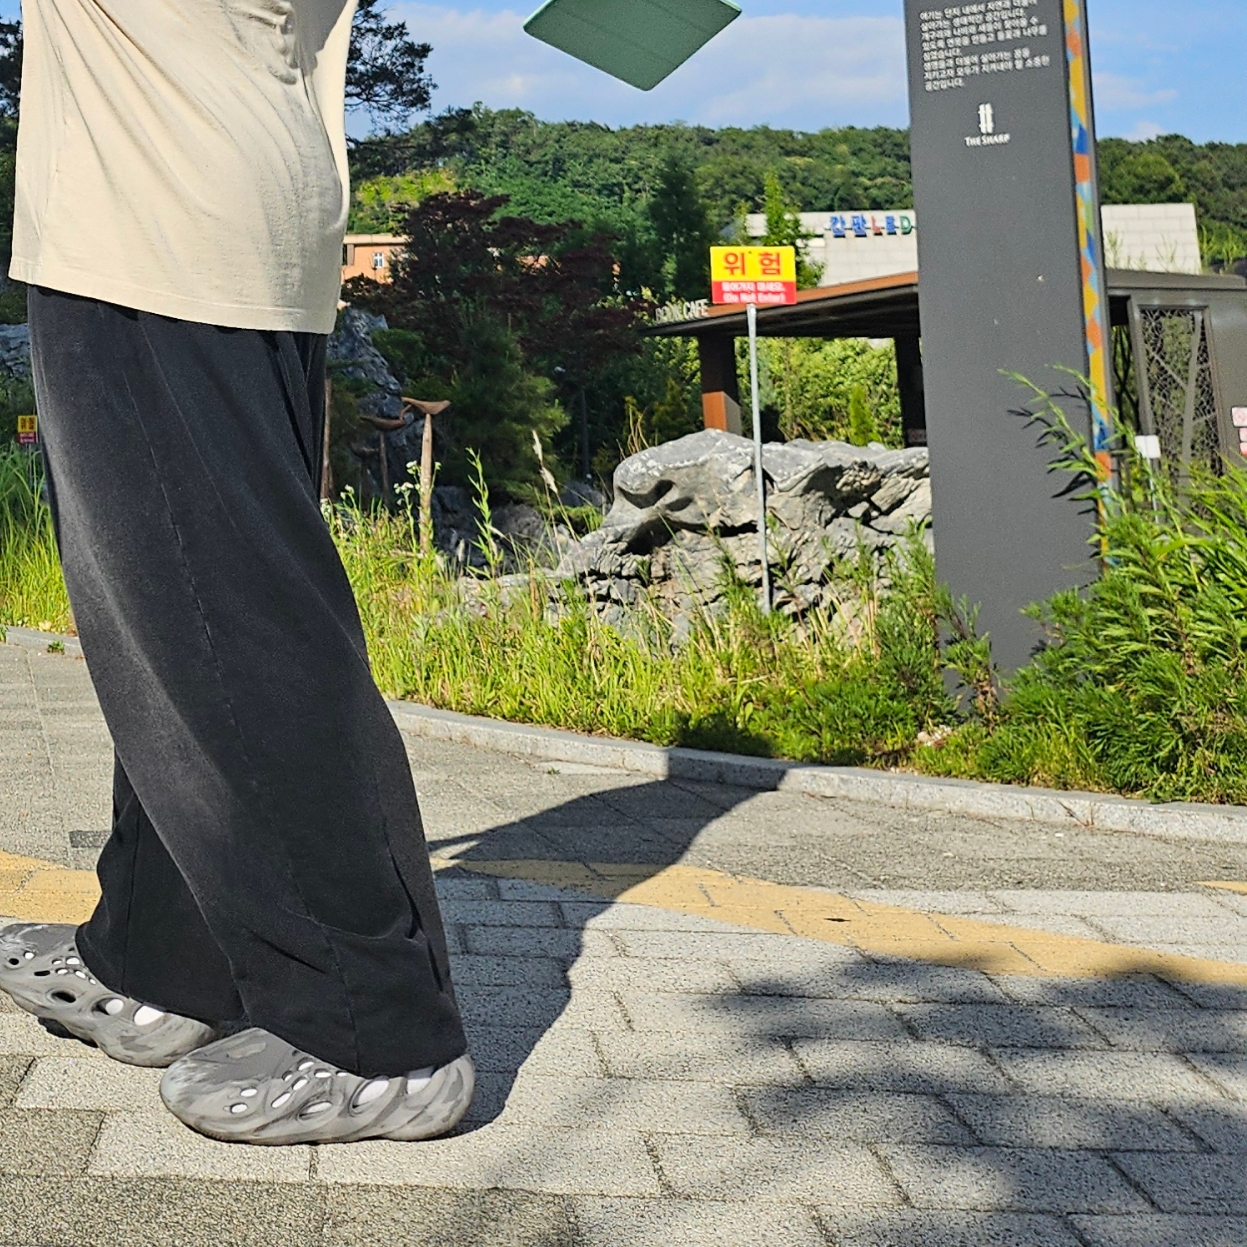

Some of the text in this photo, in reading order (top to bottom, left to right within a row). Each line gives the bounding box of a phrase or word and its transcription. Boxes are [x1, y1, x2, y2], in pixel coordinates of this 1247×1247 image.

[964, 133, 1010, 147] THE SHARP
[683, 298, 709, 320] CAFE
